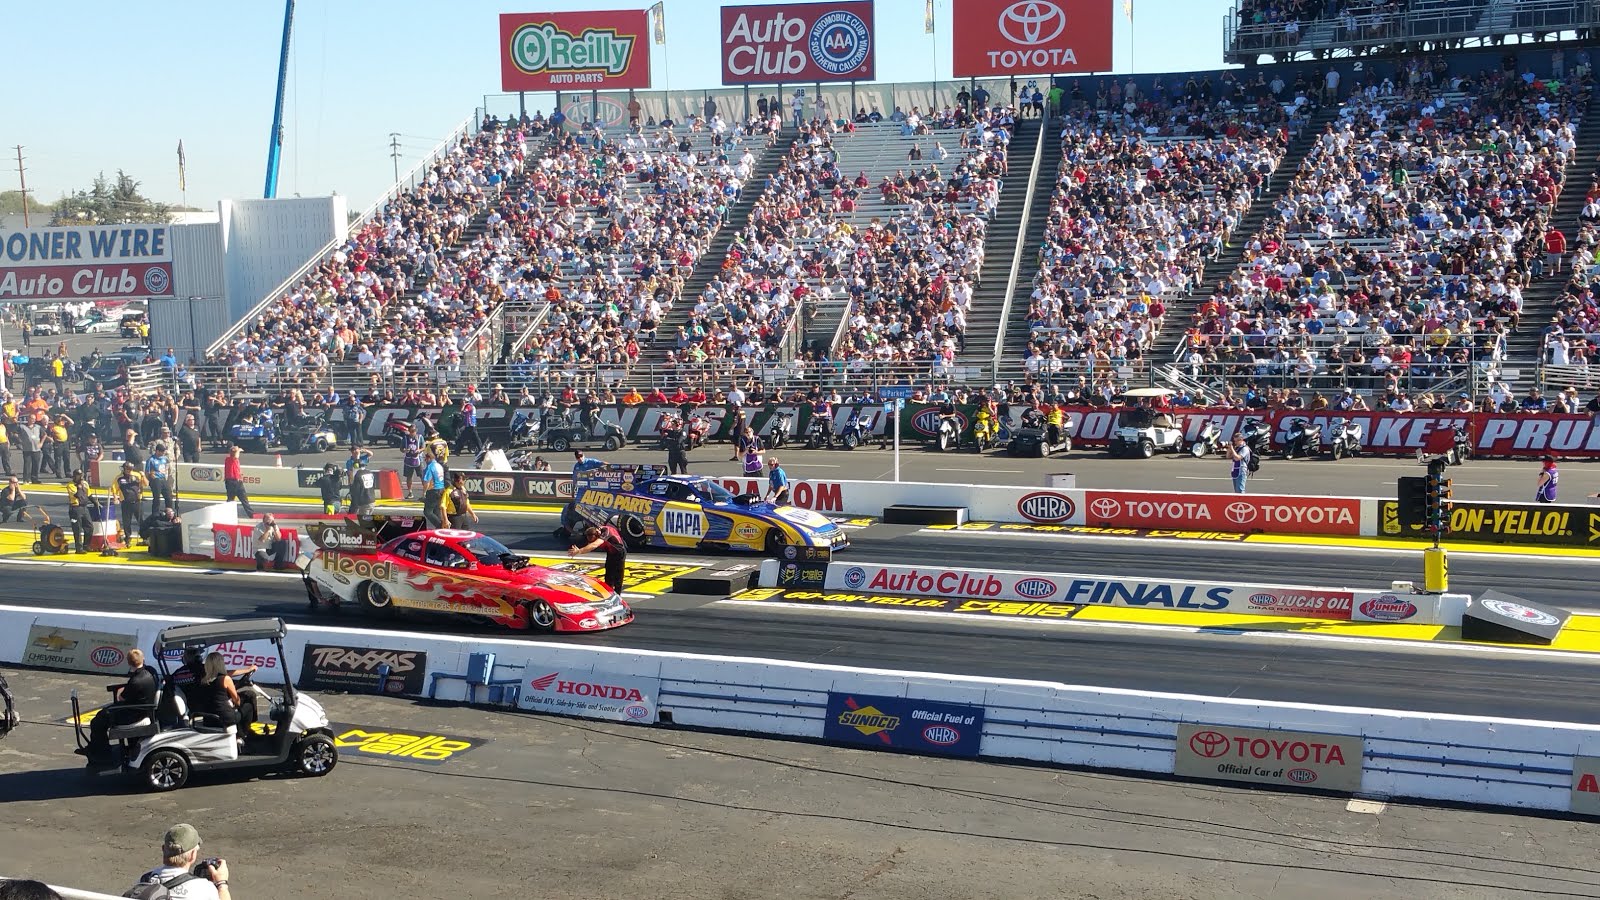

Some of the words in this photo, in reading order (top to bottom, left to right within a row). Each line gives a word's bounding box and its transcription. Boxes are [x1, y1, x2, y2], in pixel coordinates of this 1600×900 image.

[726, 12, 807, 44] Auto
[813, 13, 852, 37] AUTOMOBILE
[850, 19, 866, 36] CLUB
[517, 29, 627, 70] O'Reilly
[825, 33, 853, 49] AAA
[728, 42, 807, 76] Club
[811, 41, 838, 72] SOUTHERN
[838, 39, 868, 72] CALIFORNIA
[987, 48, 1078, 68] TOYOTA
[1353, 61, 1363, 72] 2
[550, 73, 573, 84] AUTO
[574, 72, 603, 83] PARTS
[0, 230, 82, 262] ONER
[89, 228, 165, 258] WIRE
[0, 271, 64, 296] Auto
[72, 268, 137, 295] Club
[887, 389, 905, 399] Parker
[464, 479, 483, 493] OX
[489, 482, 511, 495] NHRA
[528, 480, 553, 495] FOX
[581, 489, 614, 508] AUTO
[613, 494, 653, 514] PARTS
[1026, 497, 1067, 518] NHRA
[1125, 501, 1212, 520] TOYOTA
[665, 511, 701, 536] NAPA
[1261, 505, 1354, 525] TOYOTA
[339, 533, 363, 545] Head
[322, 551, 392, 583] Head
[783, 591, 948, 608] GO-ON-YELLO!
[1020, 578, 1052, 596] NHRA
[1064, 579, 1234, 611] FINALS
[1252, 595, 1275, 605] NHRA
[1276, 594, 1325, 609] LUCAS
[1327, 597, 1350, 610] OIL
[95, 648, 120, 664] NHRA
[216, 641, 247, 653] ALL
[28, 652, 76, 664] CHEVROLET
[221, 652, 277, 668] CCESS
[312, 647, 417, 673] TRAXXAS
[556, 680, 644, 703] HONDA
[525, 695, 544, 704] Official
[543, 696, 555, 706] ATV,
[555, 699, 587, 709] Side-by-Side
[588, 702, 599, 710] and
[599, 704, 618, 713] Scooter
[618, 706, 625, 714] of
[841, 713, 899, 730] SUNOCO
[911, 709, 944, 722] Official
[944, 713, 964, 724] Fuel
[964, 714, 975, 726] of
[928, 727, 956, 743] NHRA
[1233, 735, 1346, 766] TOYOTA
[1217, 762, 1253, 776] Official
[1254, 765, 1271, 777] Car
[1272, 767, 1284, 779] of
[1290, 769, 1316, 782] NHRA
